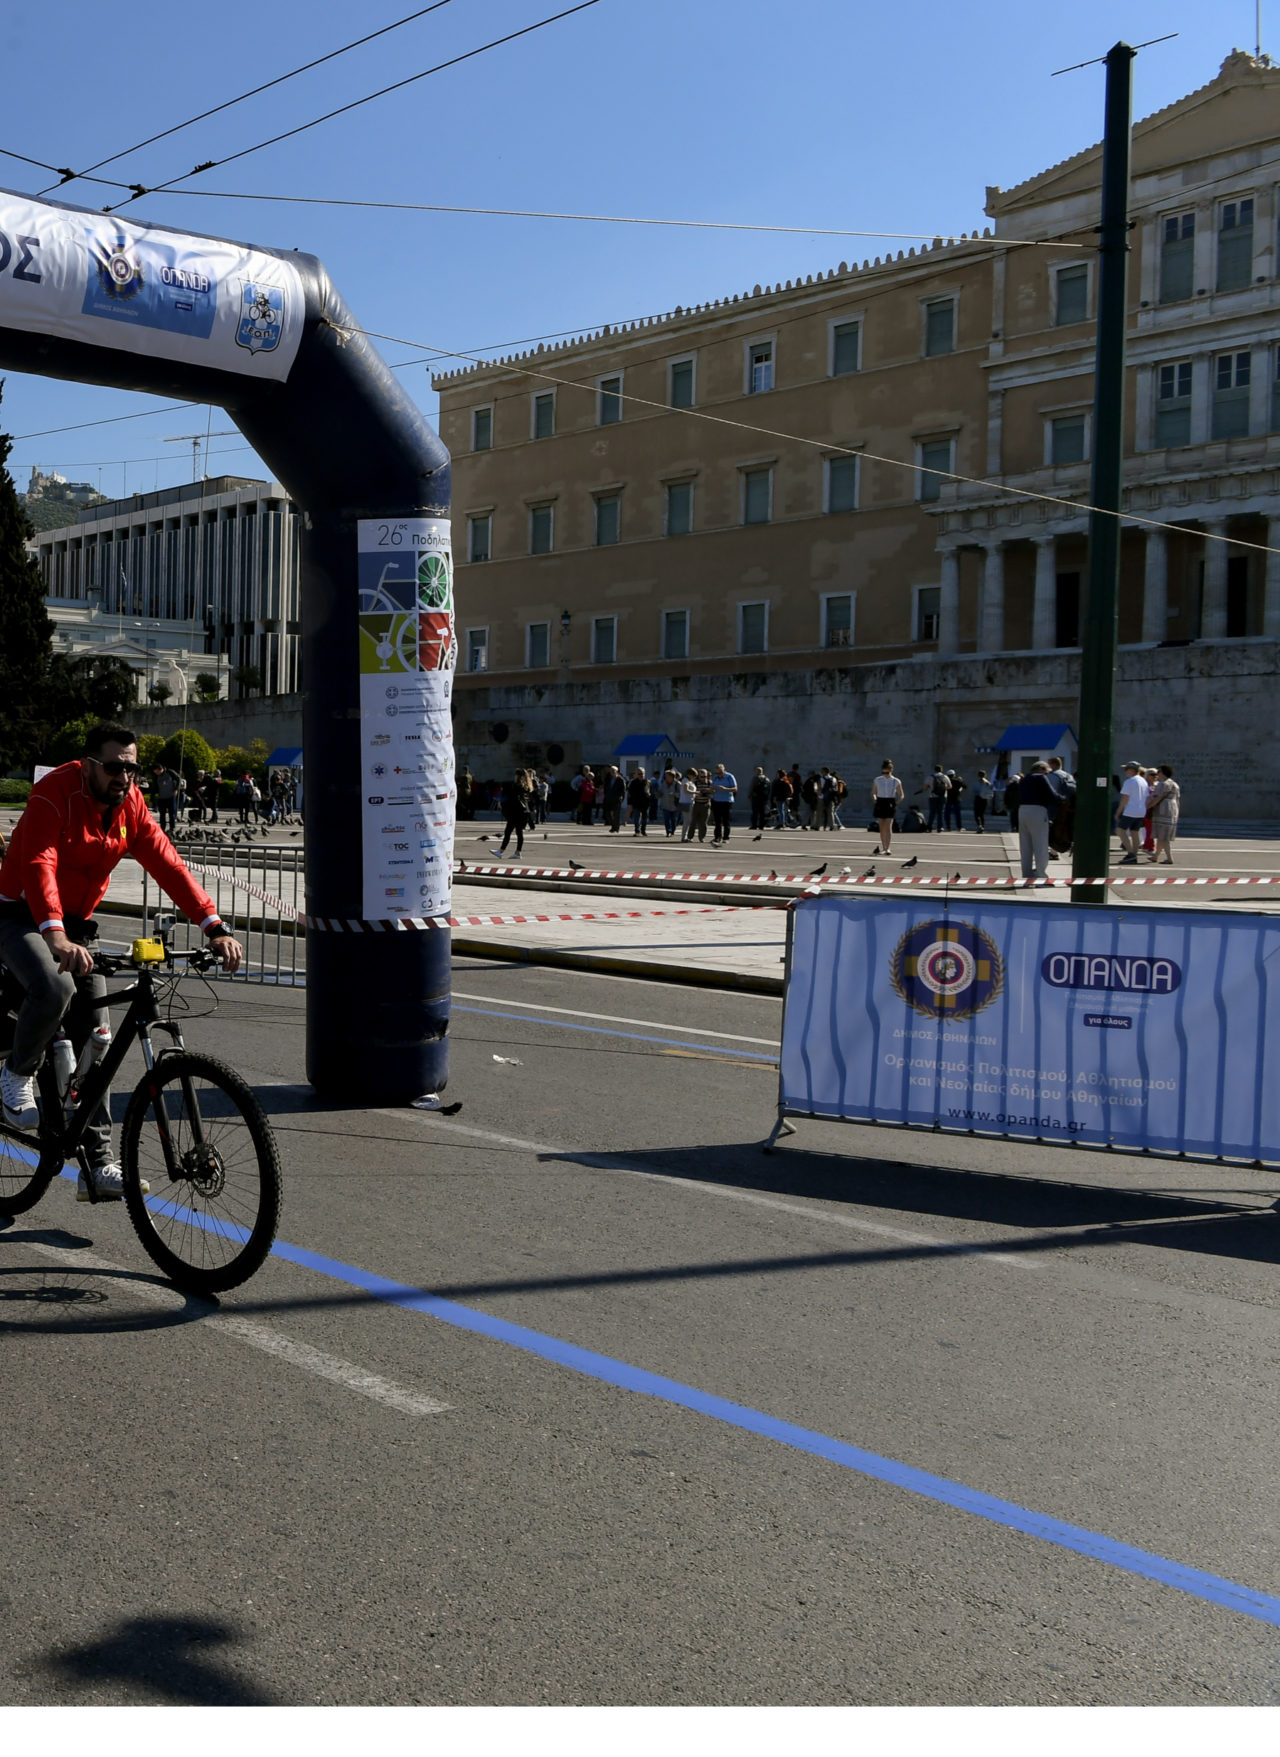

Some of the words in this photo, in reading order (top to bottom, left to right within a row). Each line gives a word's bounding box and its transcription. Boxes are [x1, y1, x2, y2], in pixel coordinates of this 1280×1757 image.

[1088, 1017, 1102, 1025] για
[1103, 1016, 1129, 1027] όλους
[893, 1029, 934, 1041] ΔΗΜΟΣ
[935, 1032, 997, 1046] ΑΘΗΝΑΙΩΝ
[884, 1053, 974, 1075] Οργανισμός
[978, 1062, 1071, 1085] Πολιτισμού,
[1076, 1069, 1177, 1093] Αθλητισμού
[909, 1076, 932, 1088] και
[935, 1076, 1007, 1097] Νεολαίας
[1010, 1082, 1062, 1103] δήμου
[1065, 1088, 1149, 1110] Αθηναίων
[948, 1105, 1087, 1133] www.opanda.gr
